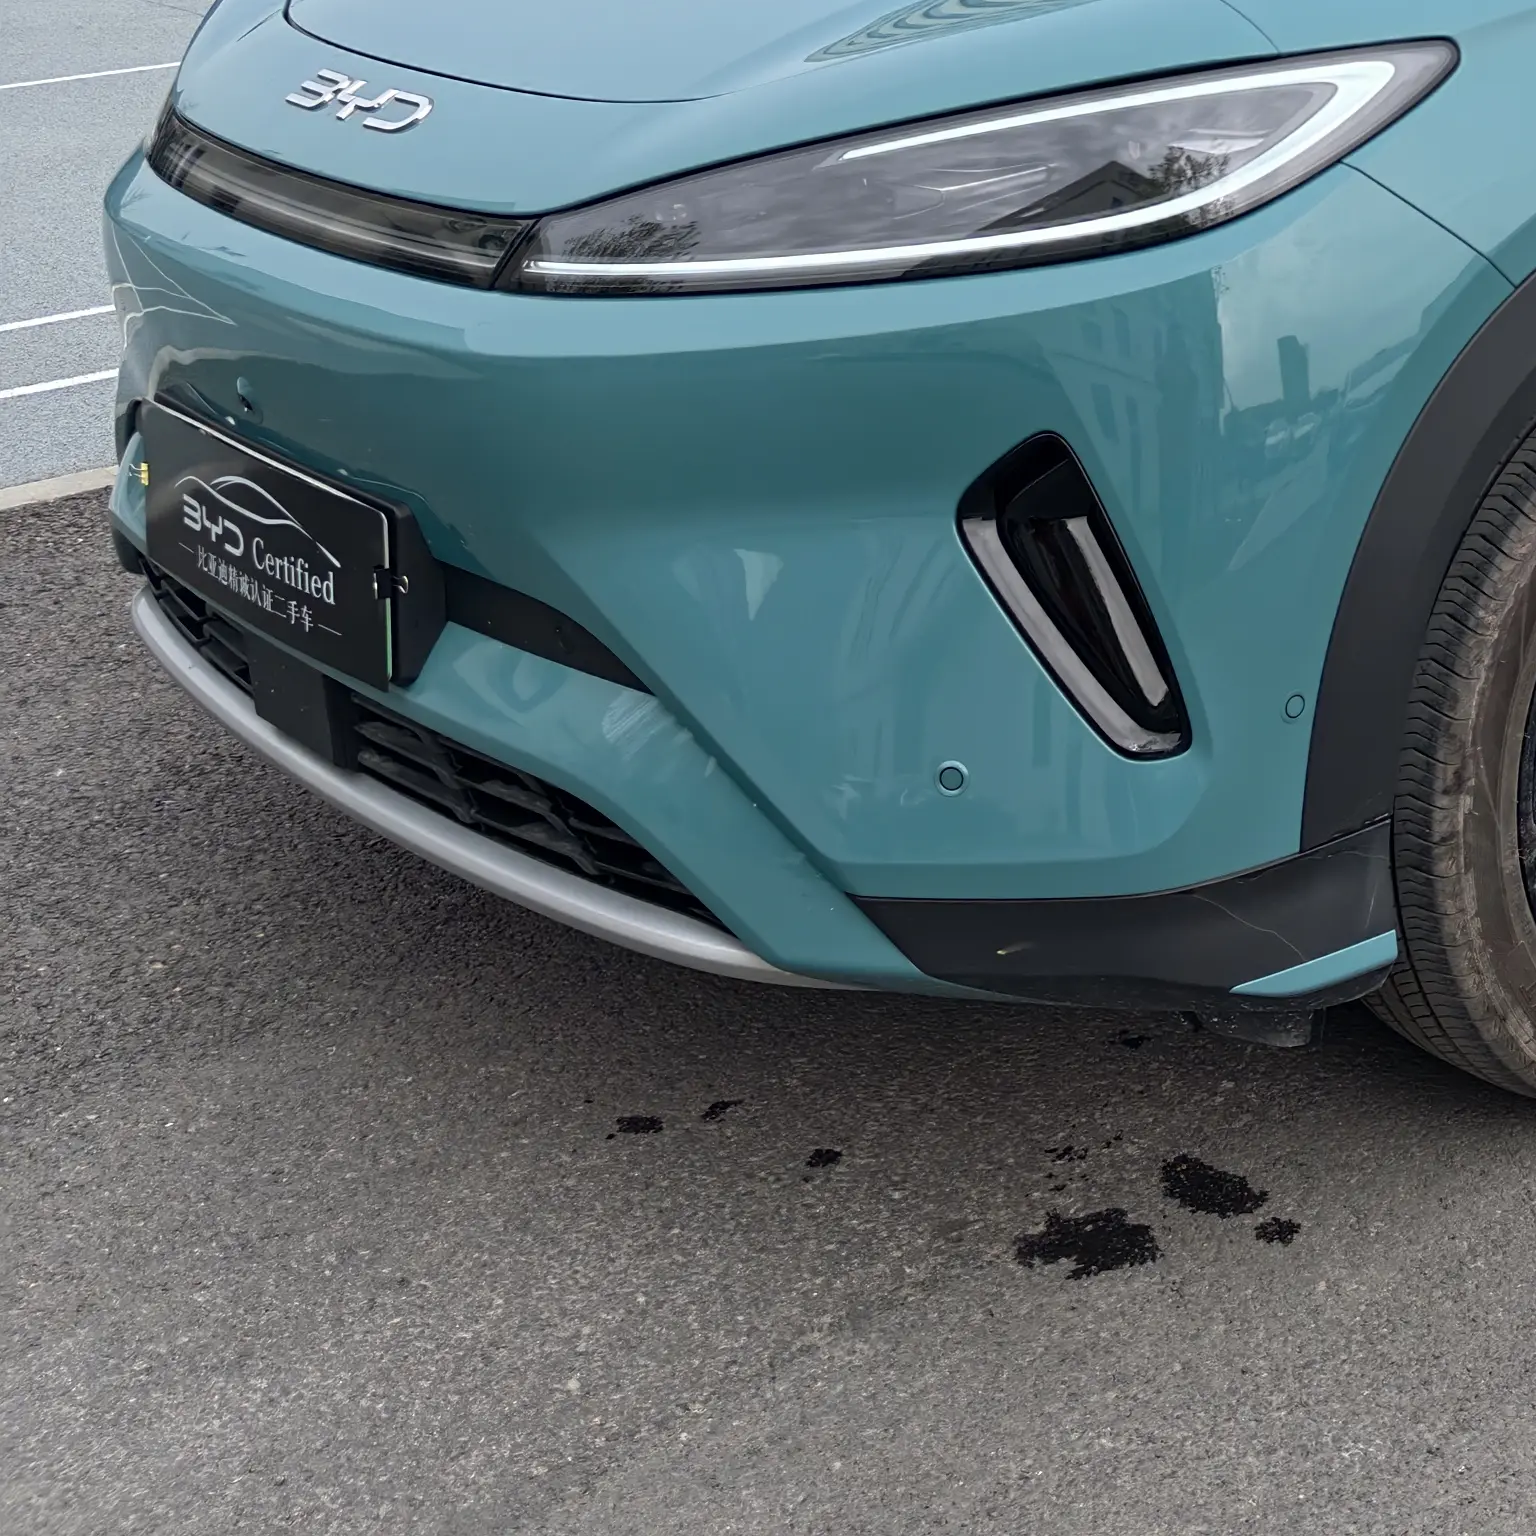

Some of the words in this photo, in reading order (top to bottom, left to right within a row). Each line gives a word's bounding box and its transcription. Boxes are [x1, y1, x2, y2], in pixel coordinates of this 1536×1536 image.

[285, 69, 433, 133] BYD
[183, 493, 245, 556] BYD
[252, 537, 336, 605] Certified
[197, 545, 313, 632] 比亚迪精诚认证二手车
